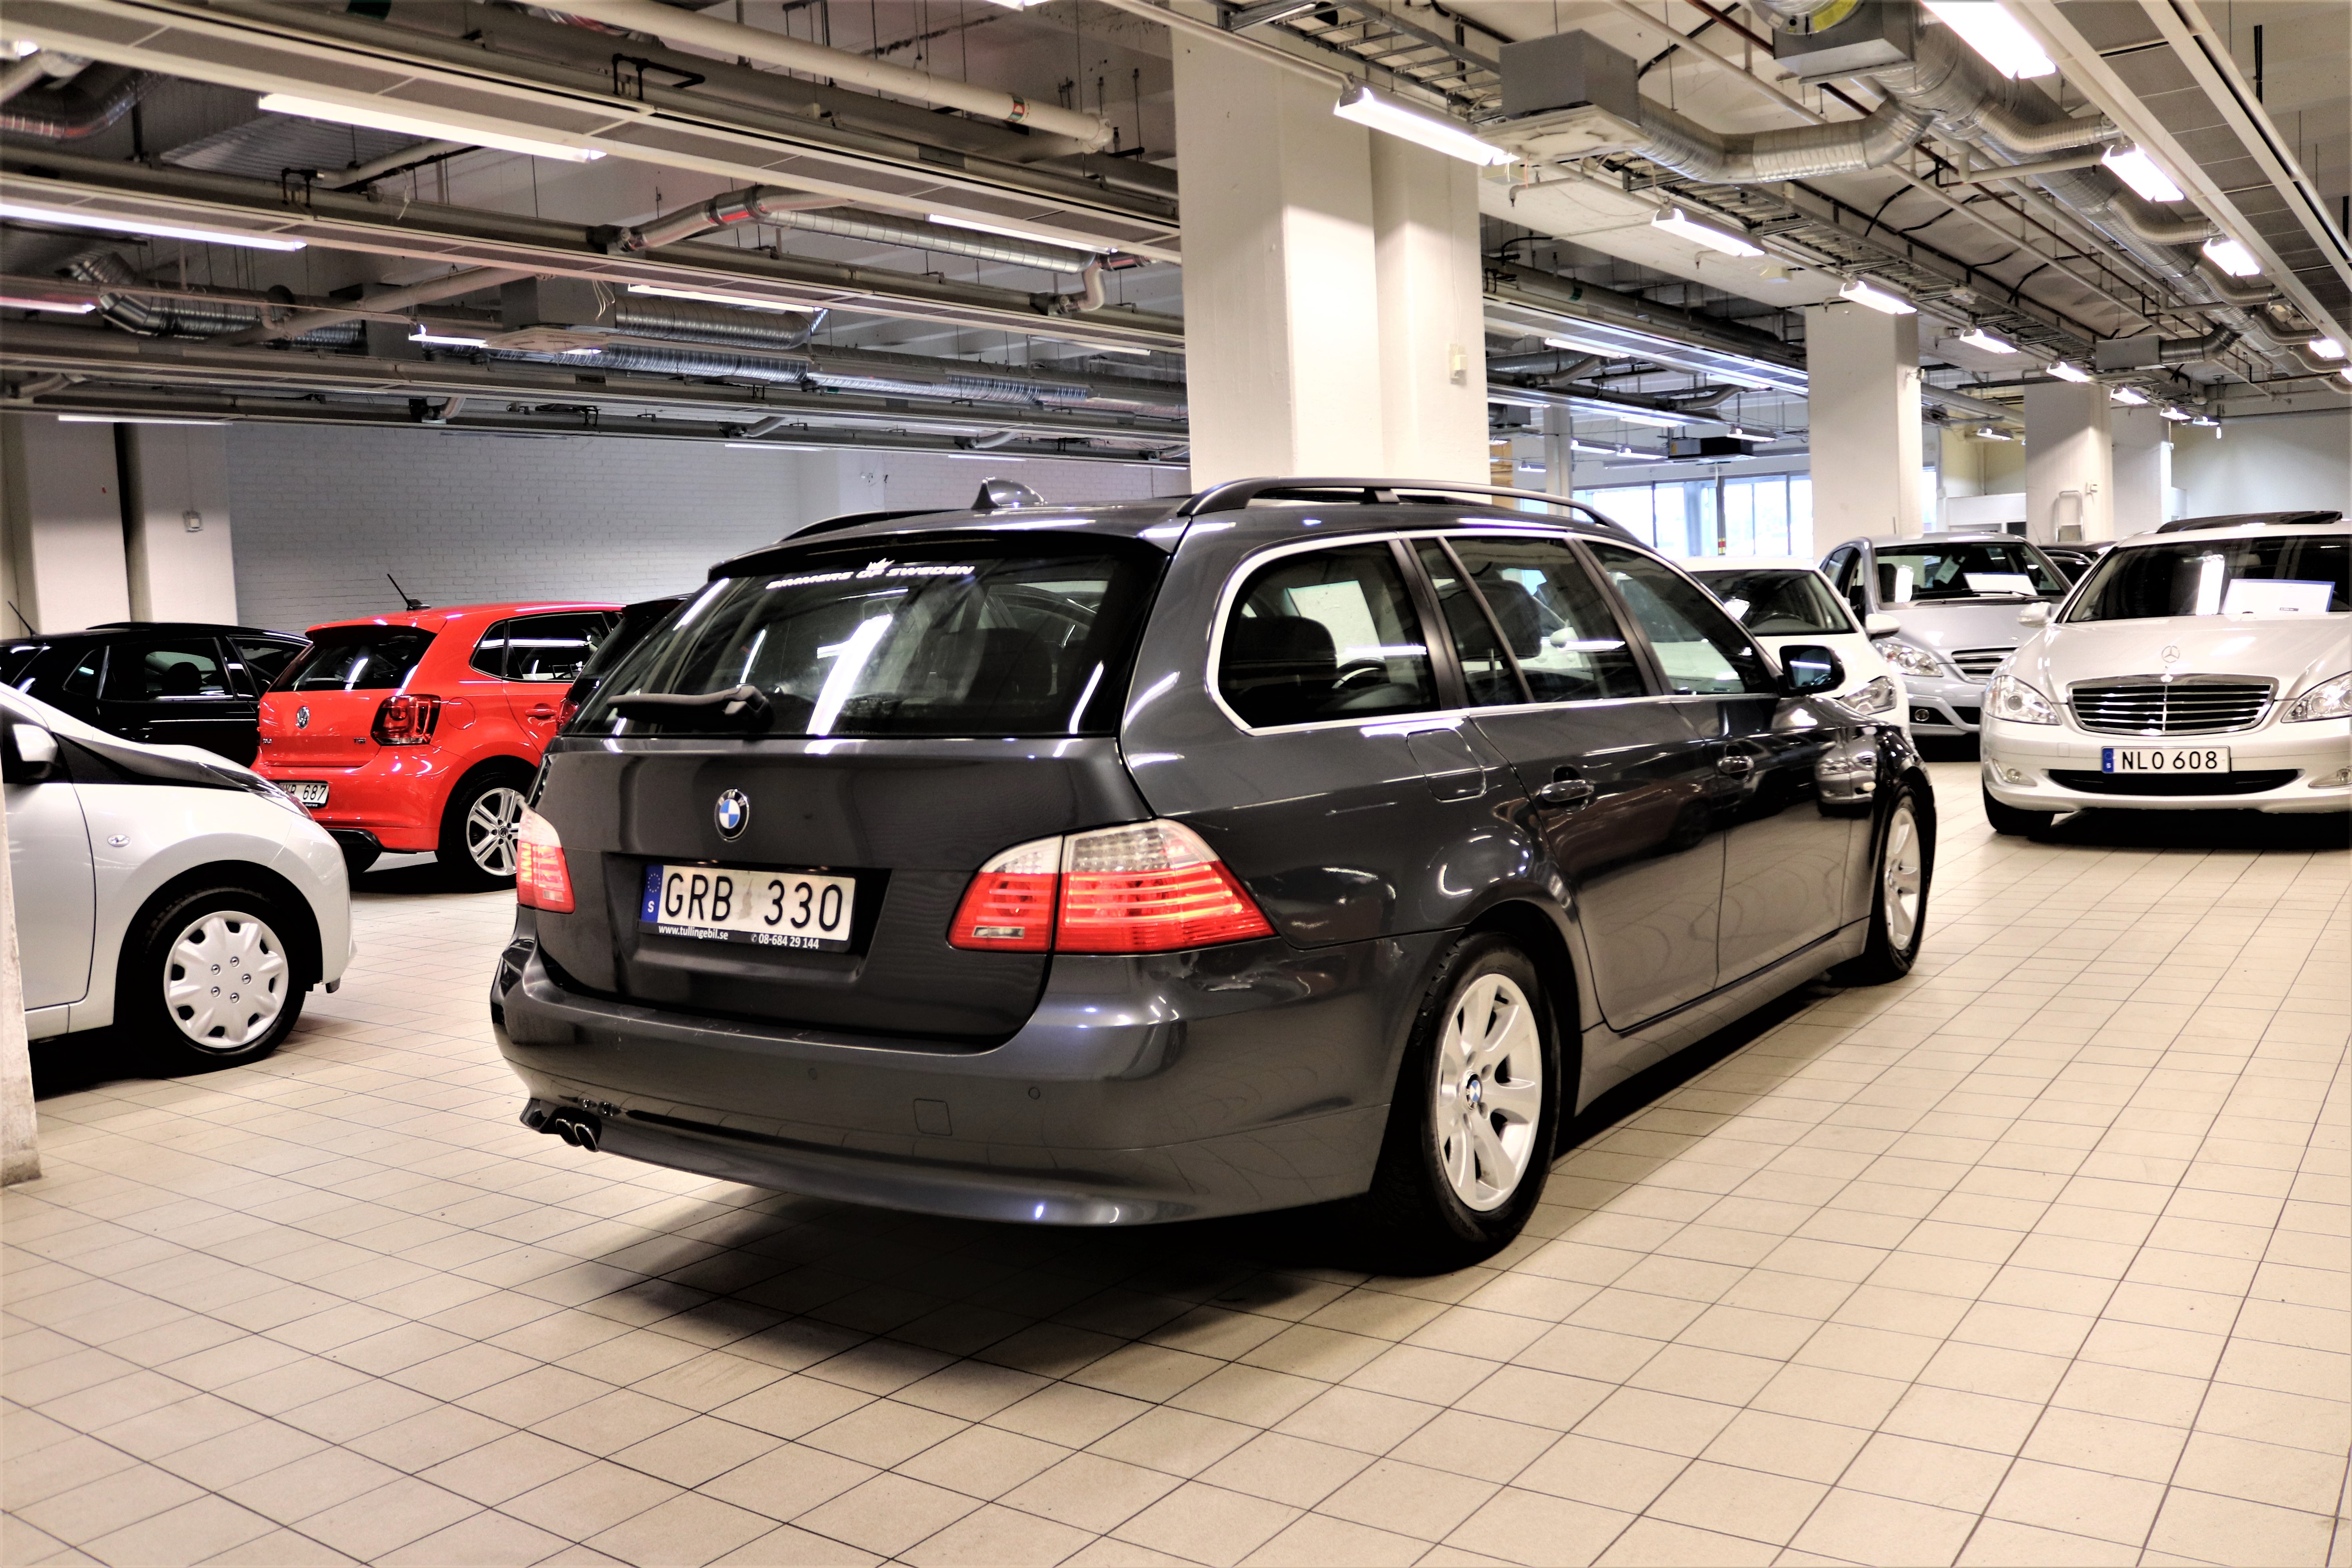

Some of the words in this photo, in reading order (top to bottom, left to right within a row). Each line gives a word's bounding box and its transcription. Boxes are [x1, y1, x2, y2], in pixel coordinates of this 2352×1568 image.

[856, 570, 885, 579] OF
[886, 566, 975, 577] SWEDEN
[2122, 751, 2164, 769] NLO
[2173, 751, 2217, 769] 608
[303, 784, 327, 801] 687
[719, 791, 746, 807] BMW
[648, 900, 655, 913] S
[665, 873, 733, 921] GRB
[764, 879, 842, 931] 330
[658, 926, 729, 940] www.tullingebil.se
[758, 933, 788, 946] 08-684
[789, 936, 801, 947] 29
[802, 937, 819, 949] 144
